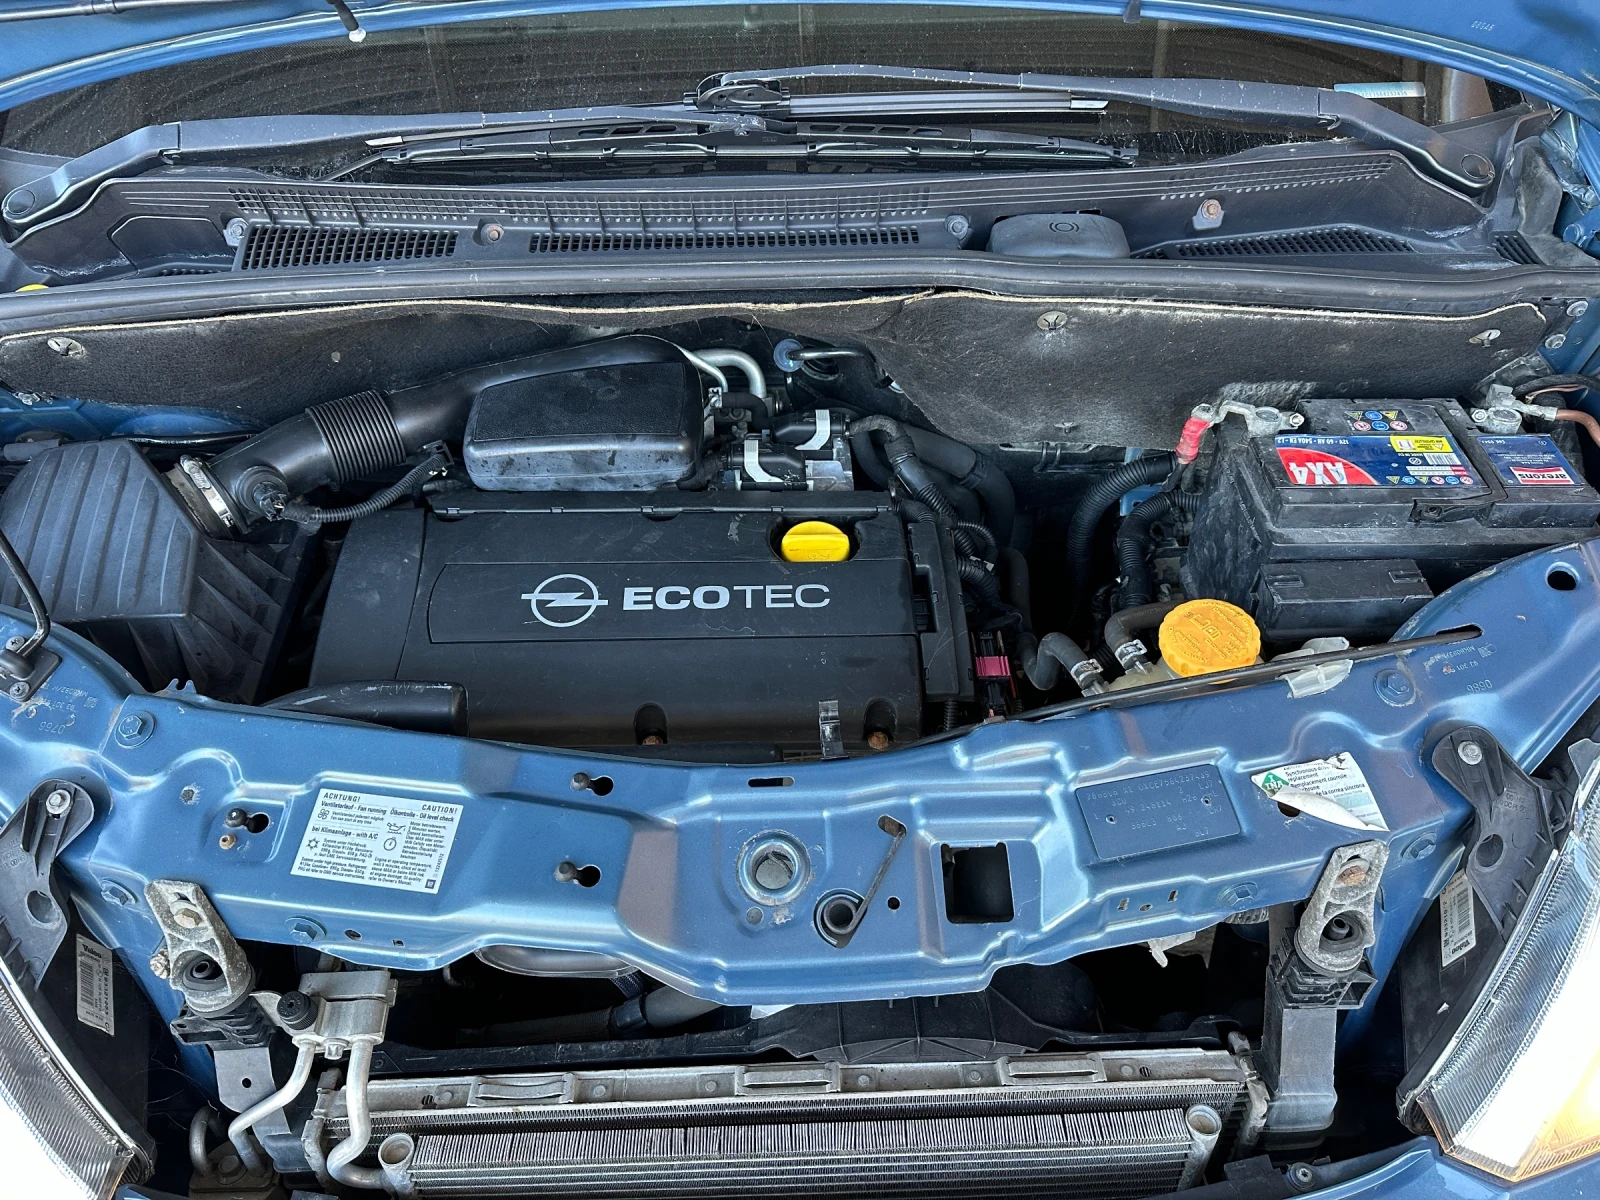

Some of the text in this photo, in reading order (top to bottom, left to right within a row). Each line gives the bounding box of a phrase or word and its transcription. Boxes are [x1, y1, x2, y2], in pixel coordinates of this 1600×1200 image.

[1288, 462, 1348, 485] AX4
[623, 584, 830, 610] ECOTEC
[39, 722, 66, 734] 0766
[1288, 772, 1318, 782] replacement
[322, 792, 361, 802] ACHTUNG!
[320, 800, 354, 810] Ventilatorlauf
[366, 806, 387, 815] running
[389, 807, 416, 817] Ölkontrolle
[420, 804, 458, 814] CAUTION!
[320, 826, 352, 836] Klimaanlage
[82, 944, 102, 958] Valeo
